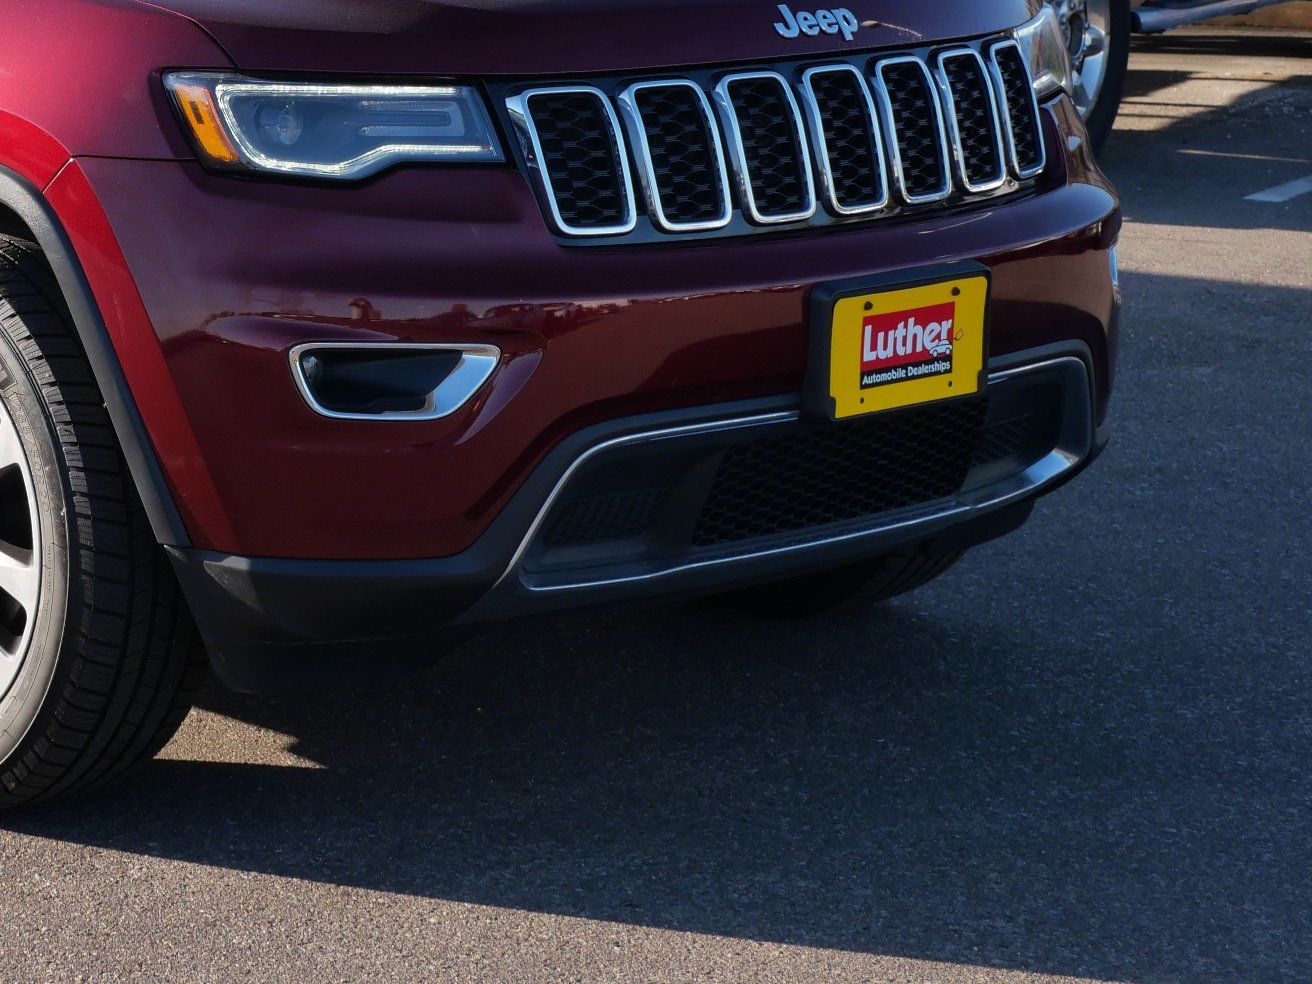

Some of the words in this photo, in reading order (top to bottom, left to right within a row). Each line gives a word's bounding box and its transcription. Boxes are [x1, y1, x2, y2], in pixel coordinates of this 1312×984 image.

[773, 3, 859, 42] Jeep
[863, 317, 953, 362] Luther
[862, 368, 906, 385] Automobile
[907, 360, 951, 377] Dealerships
